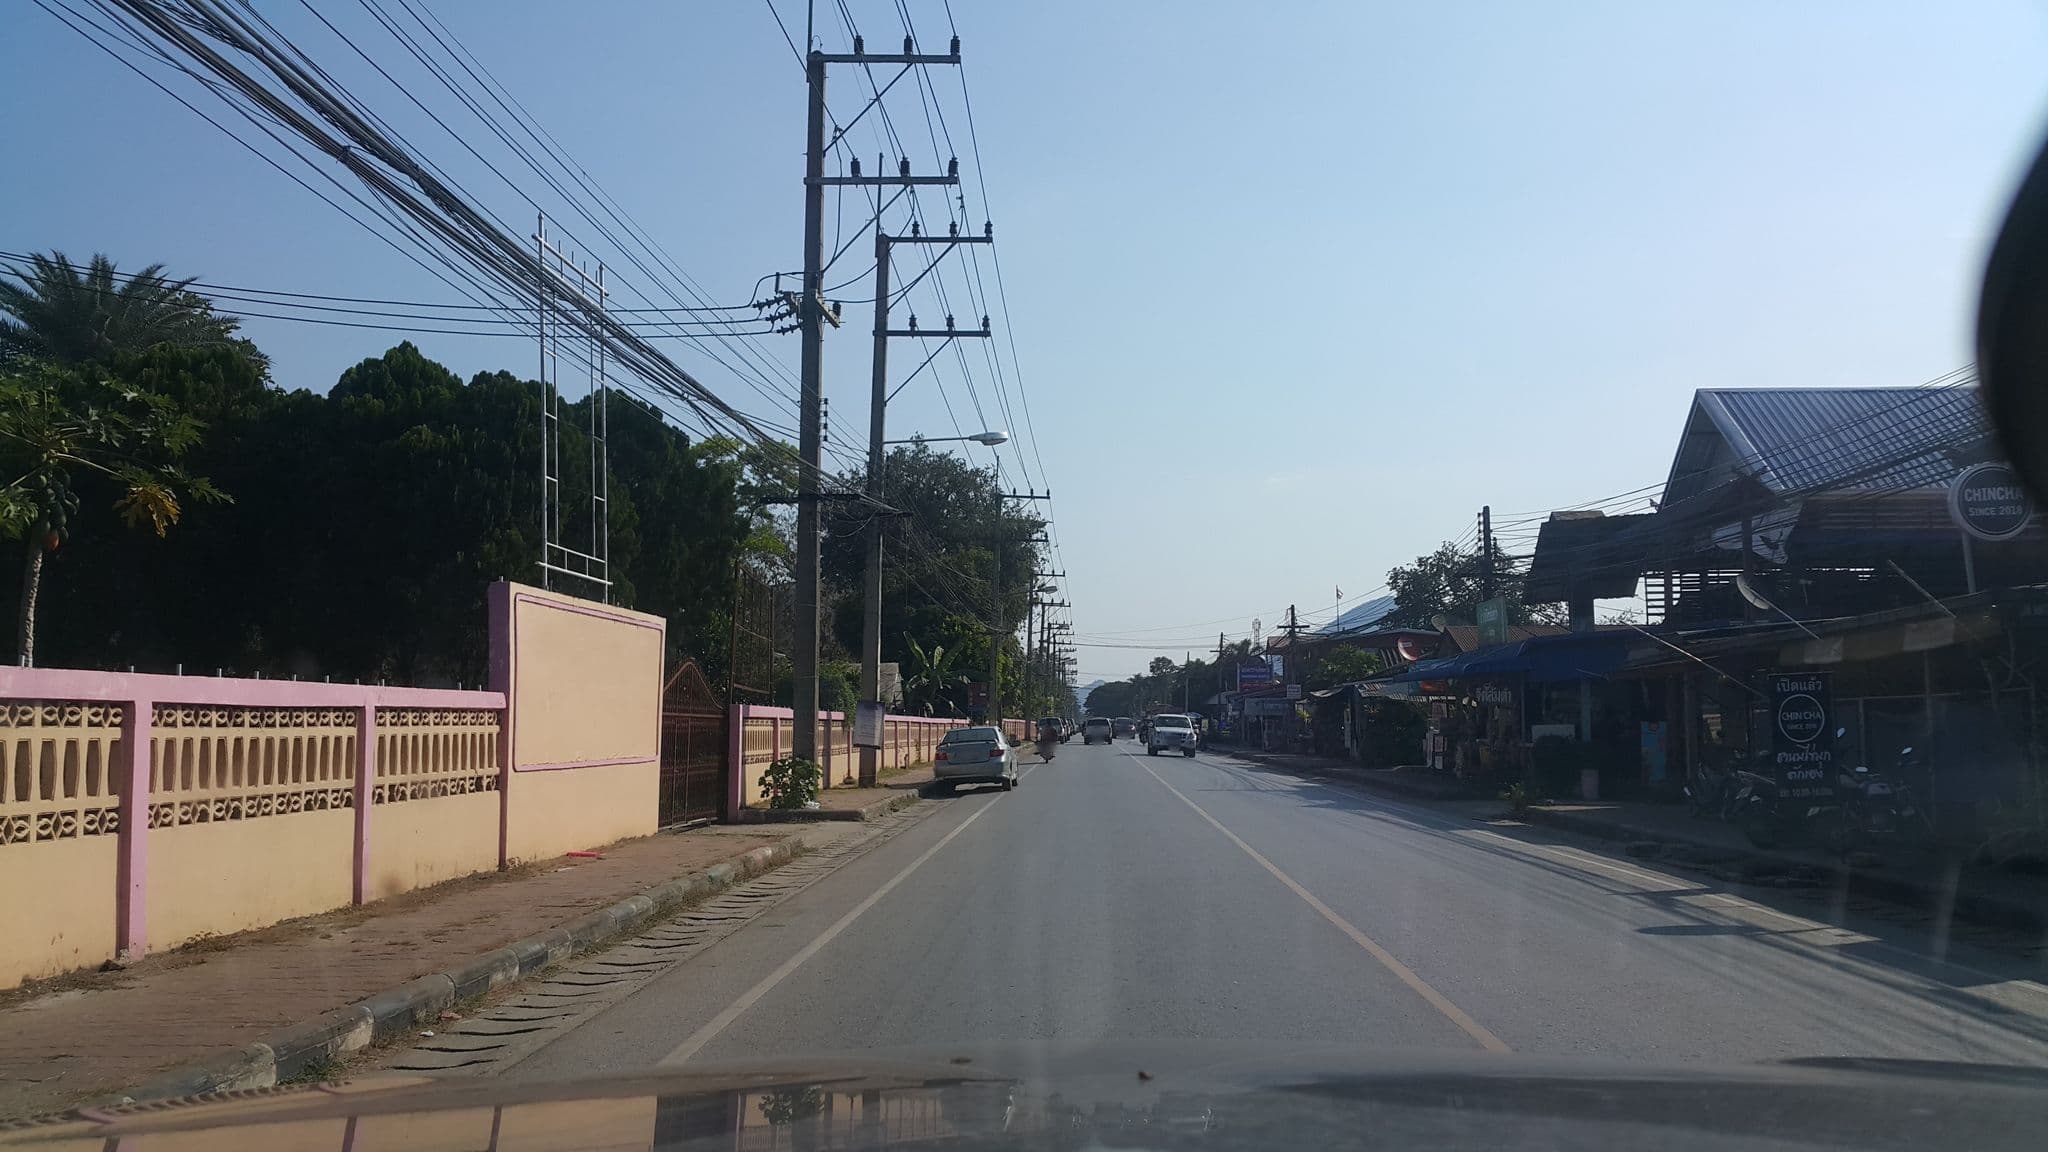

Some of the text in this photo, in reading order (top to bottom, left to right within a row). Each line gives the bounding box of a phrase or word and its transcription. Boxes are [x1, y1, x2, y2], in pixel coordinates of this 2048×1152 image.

[1964, 486, 2023, 502] CHINCHA
[1968, 507, 1997, 517] SINCE
[1776, 676, 1822, 691] เปิดแล้ว
